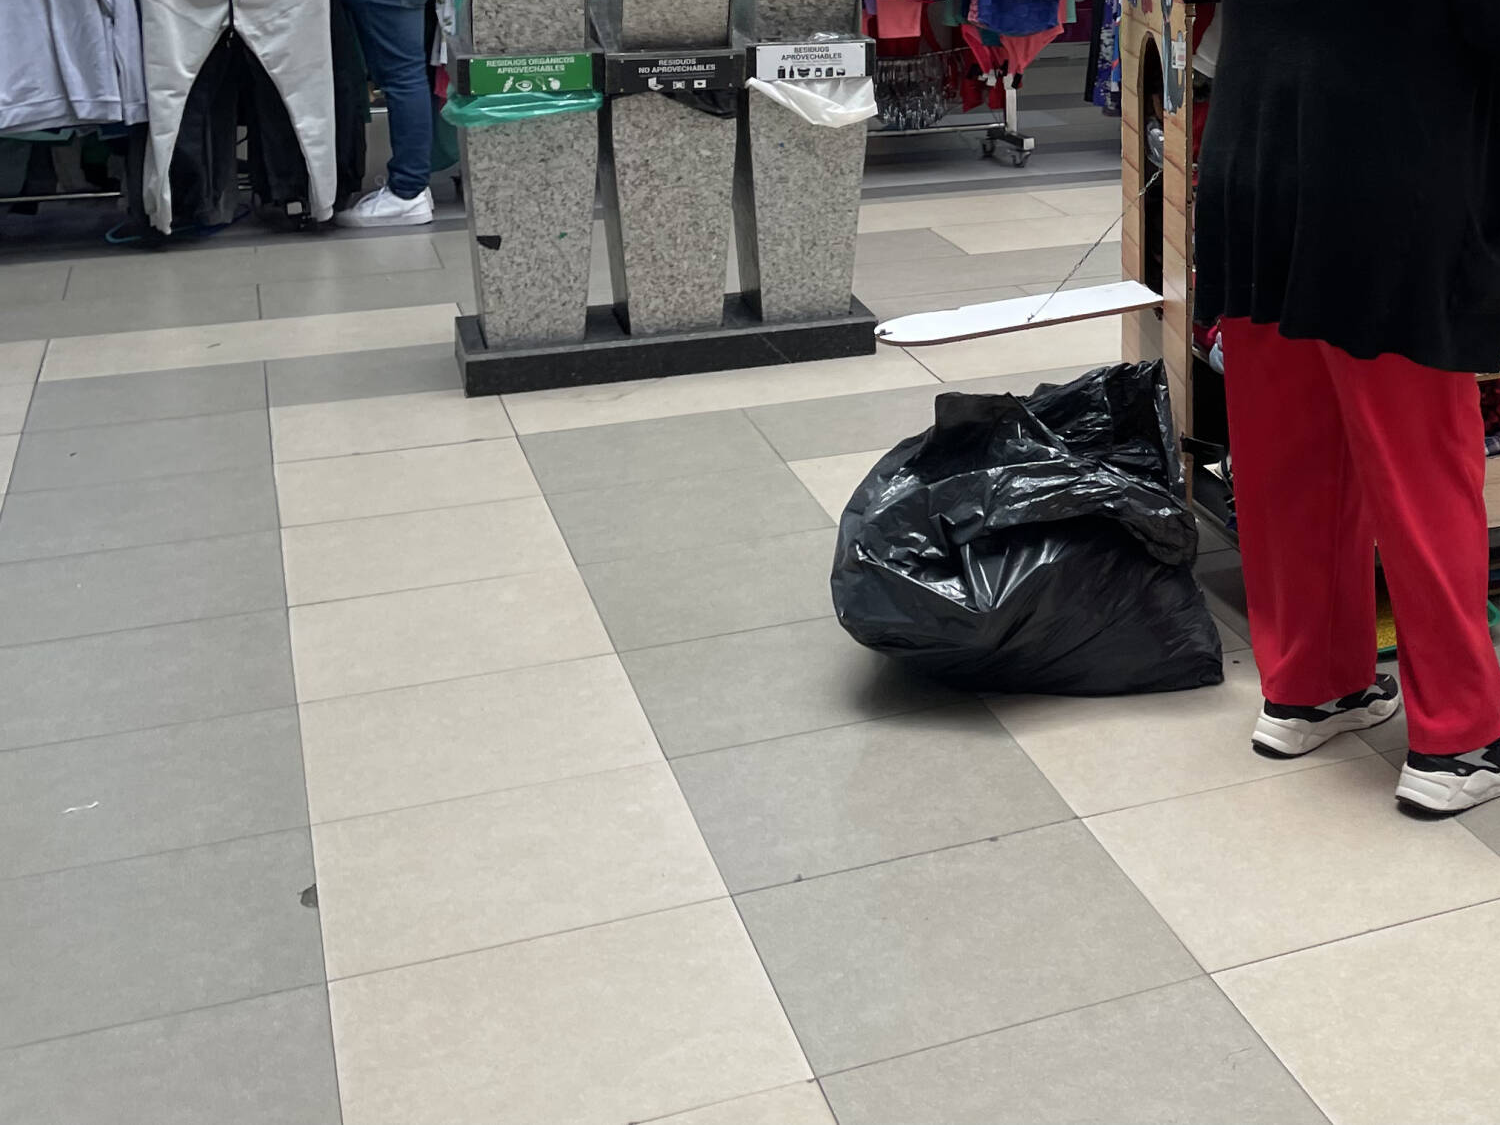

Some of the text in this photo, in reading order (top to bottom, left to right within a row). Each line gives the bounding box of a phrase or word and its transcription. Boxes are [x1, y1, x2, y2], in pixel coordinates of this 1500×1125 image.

[794, 46, 829, 54] RESIDUOS
[781, 52, 842, 61] APROVECHABLES
[486, 58, 527, 67] RESIDUOS
[658, 58, 697, 66] RESIDUOS
[497, 64, 565, 74] APROVECHABLES
[638, 64, 716, 74] NO APROVECHABLES
